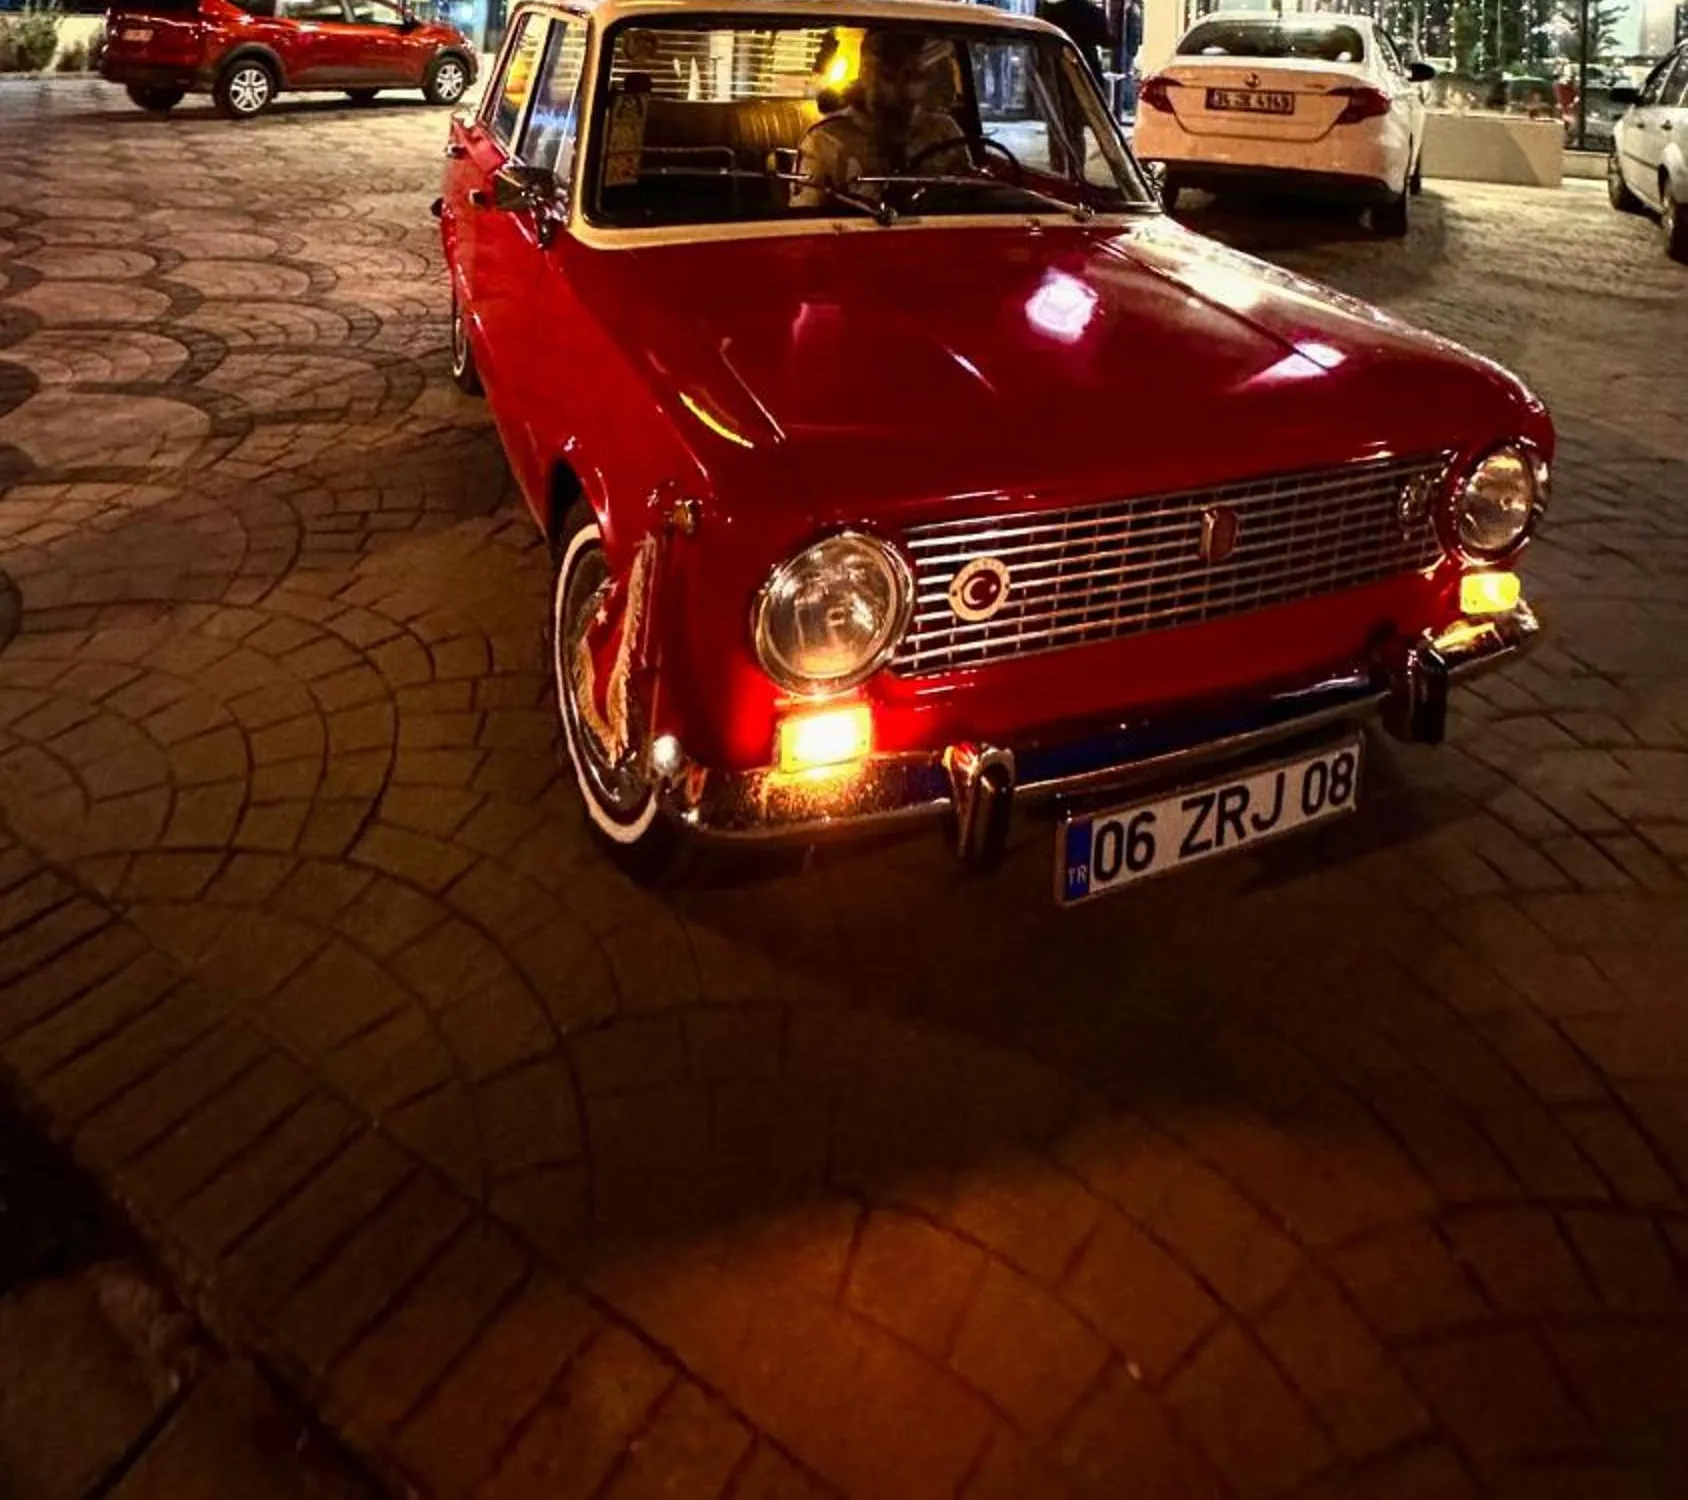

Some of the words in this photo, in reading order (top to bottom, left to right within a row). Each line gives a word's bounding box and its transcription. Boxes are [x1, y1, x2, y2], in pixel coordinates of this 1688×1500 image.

[1093, 812, 1157, 882] 06
[1178, 771, 1286, 859] ZRJ
[1301, 752, 1356, 817] 08
[1068, 864, 1087, 888] TR
